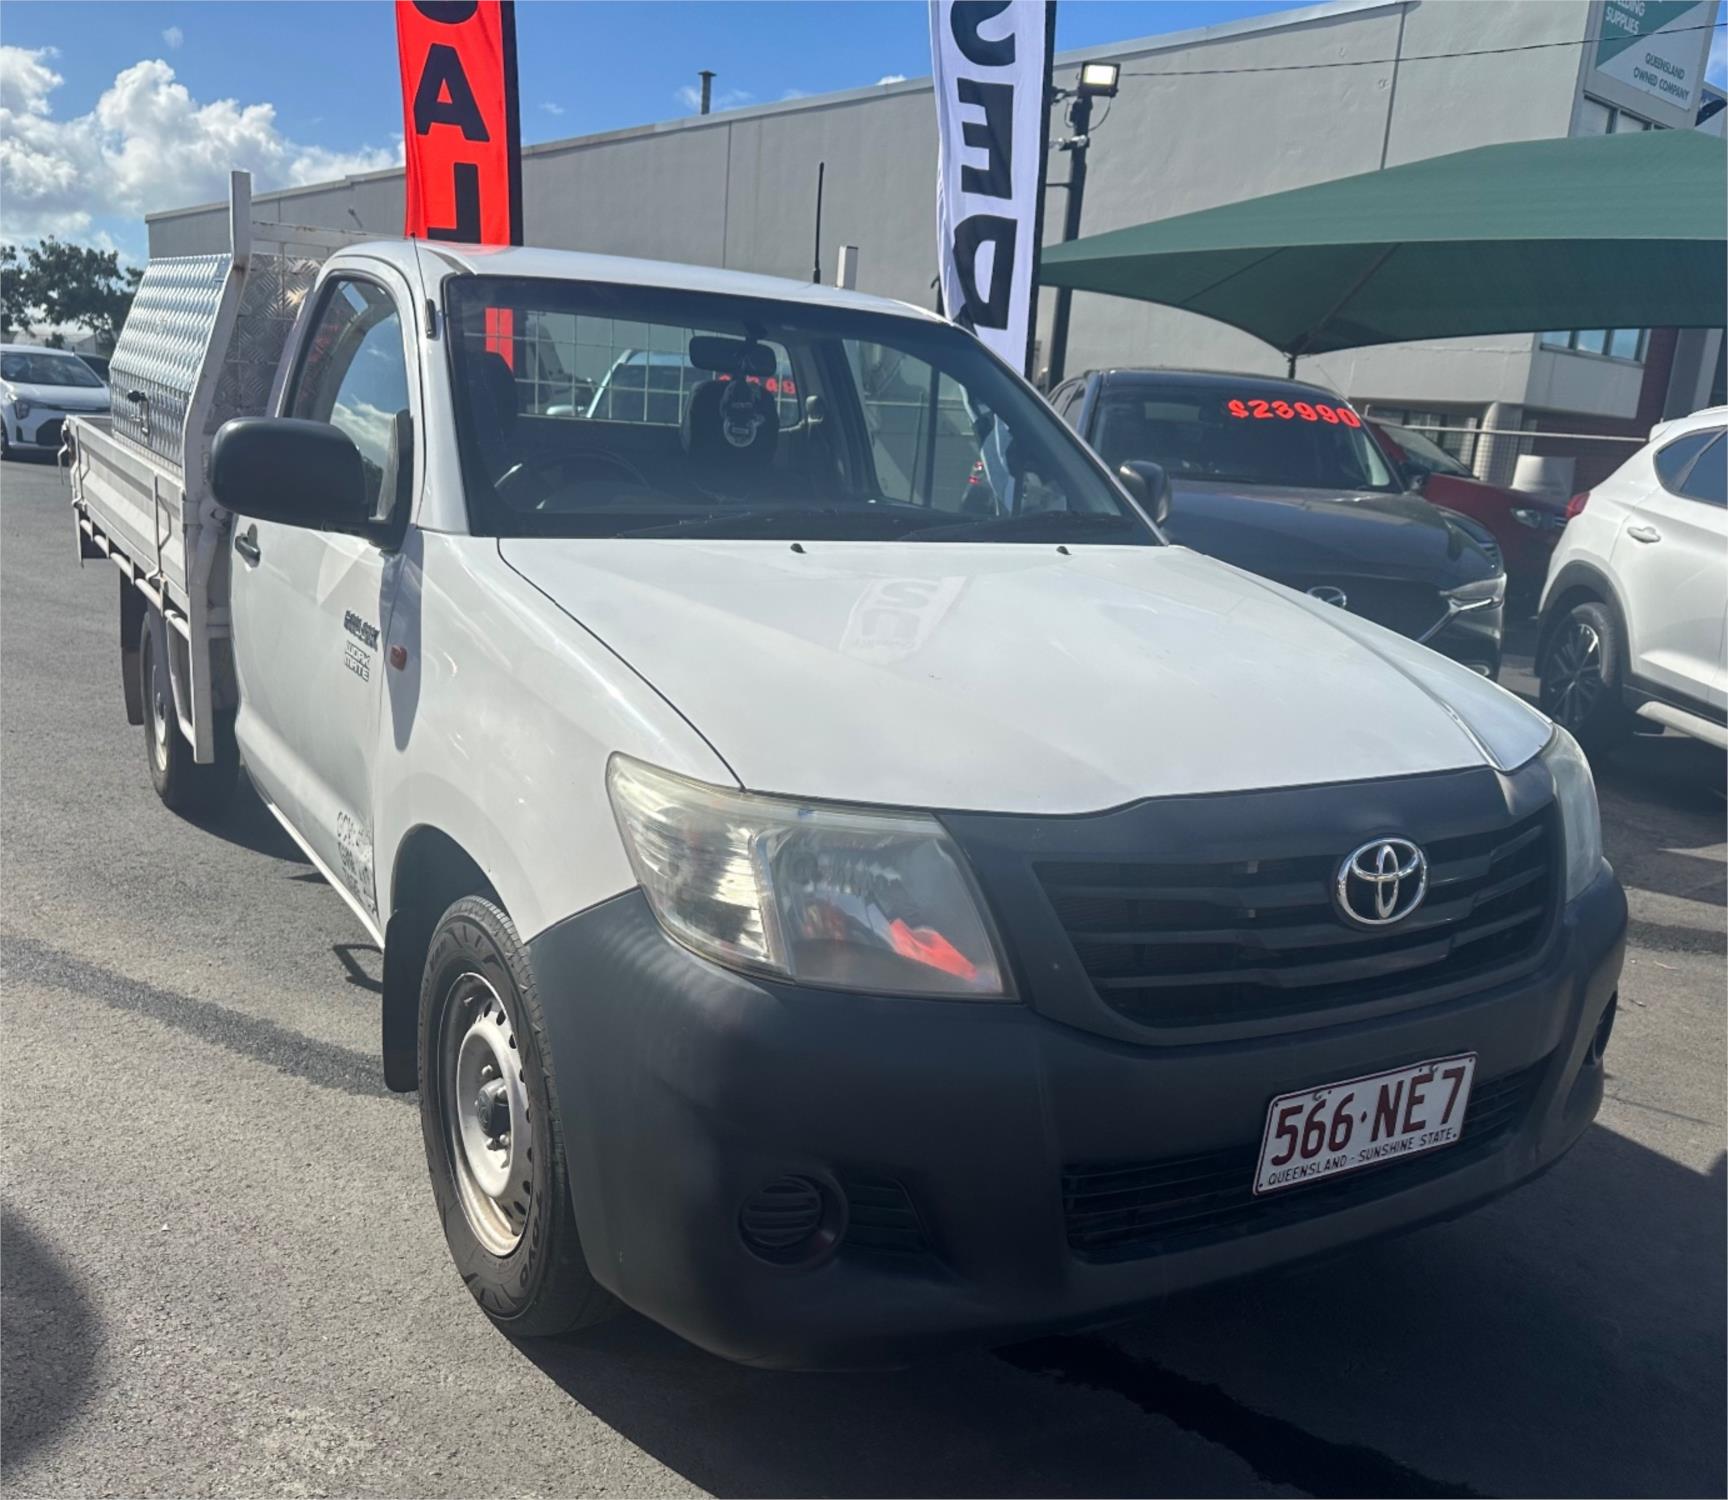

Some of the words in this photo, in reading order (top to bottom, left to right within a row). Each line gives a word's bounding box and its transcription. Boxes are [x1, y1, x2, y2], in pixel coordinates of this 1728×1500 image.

[1605, 7, 1639, 35] SUPPLIES
[1645, 53, 1685, 80] QUEENSLAND
[1633, 66, 1658, 87] OWNED
[1659, 78, 1690, 100] COMPANY
[1268, 1154, 1347, 1185] QUEENSLAND
[1358, 1137, 1414, 1161] SUNSHINE
[1419, 1127, 1453, 1146] STATE
